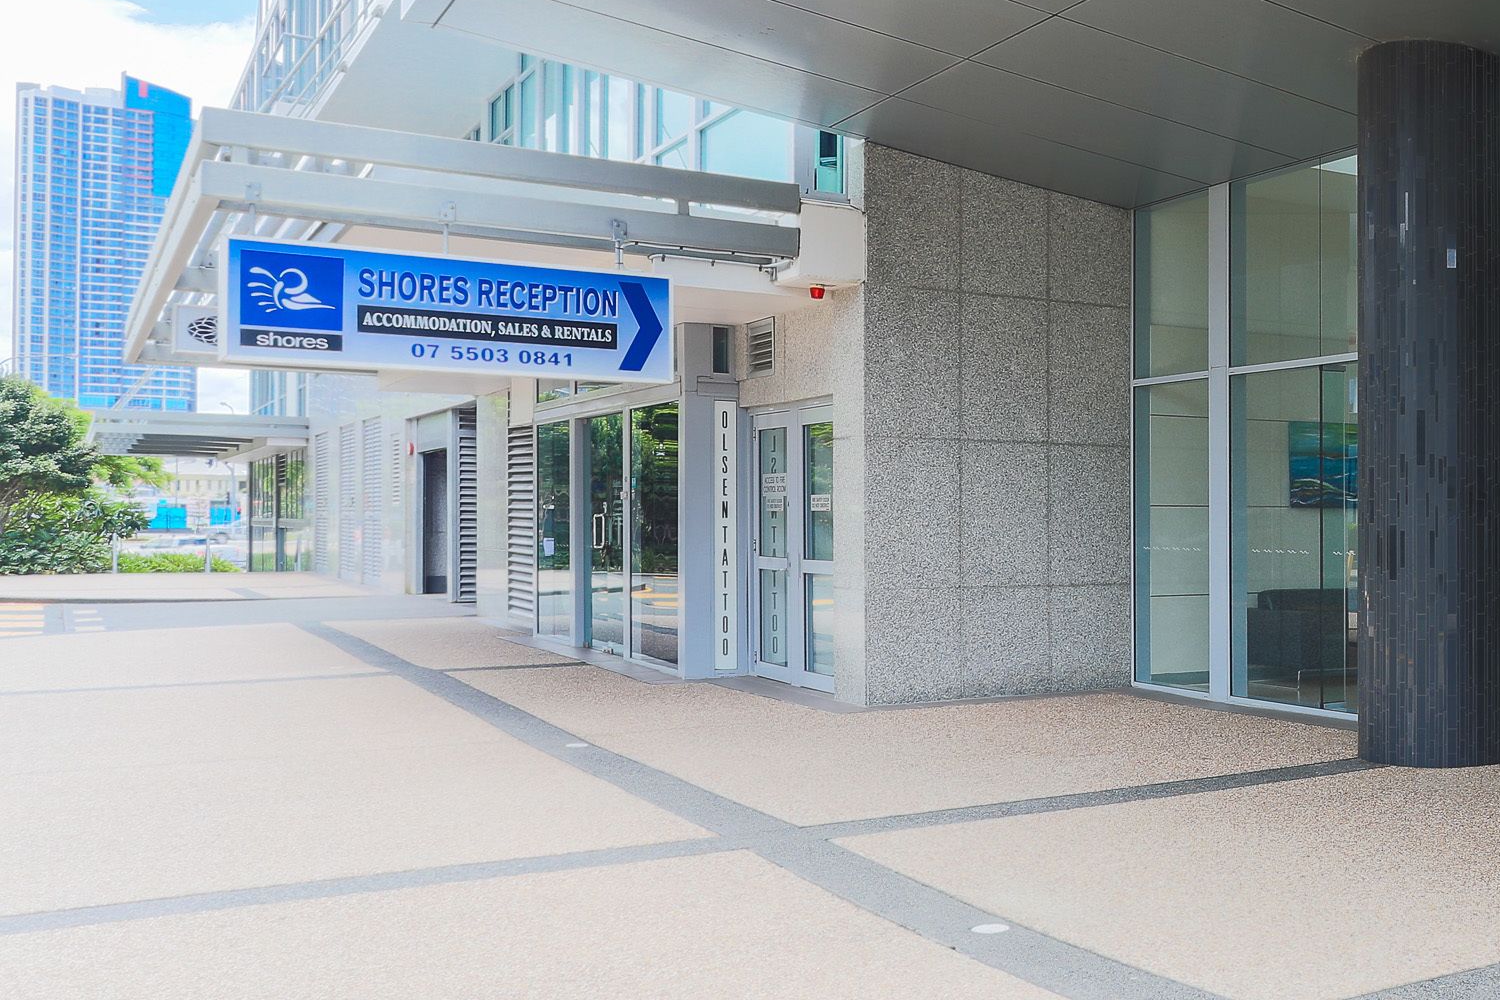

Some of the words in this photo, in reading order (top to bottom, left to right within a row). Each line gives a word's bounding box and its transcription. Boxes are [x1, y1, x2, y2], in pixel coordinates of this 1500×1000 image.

[358, 267, 470, 306] SHORES
[479, 279, 620, 318] RECEPTION
[255, 332, 329, 350] shores
[362, 312, 496, 338] ACCOMMODATION,
[498, 322, 539, 339] SALES
[541, 324, 551, 339] &
[554, 326, 613, 343] RENTALS
[410, 343, 440, 360] 07
[450, 346, 510, 364] 5503
[518, 349, 573, 367] 0841
